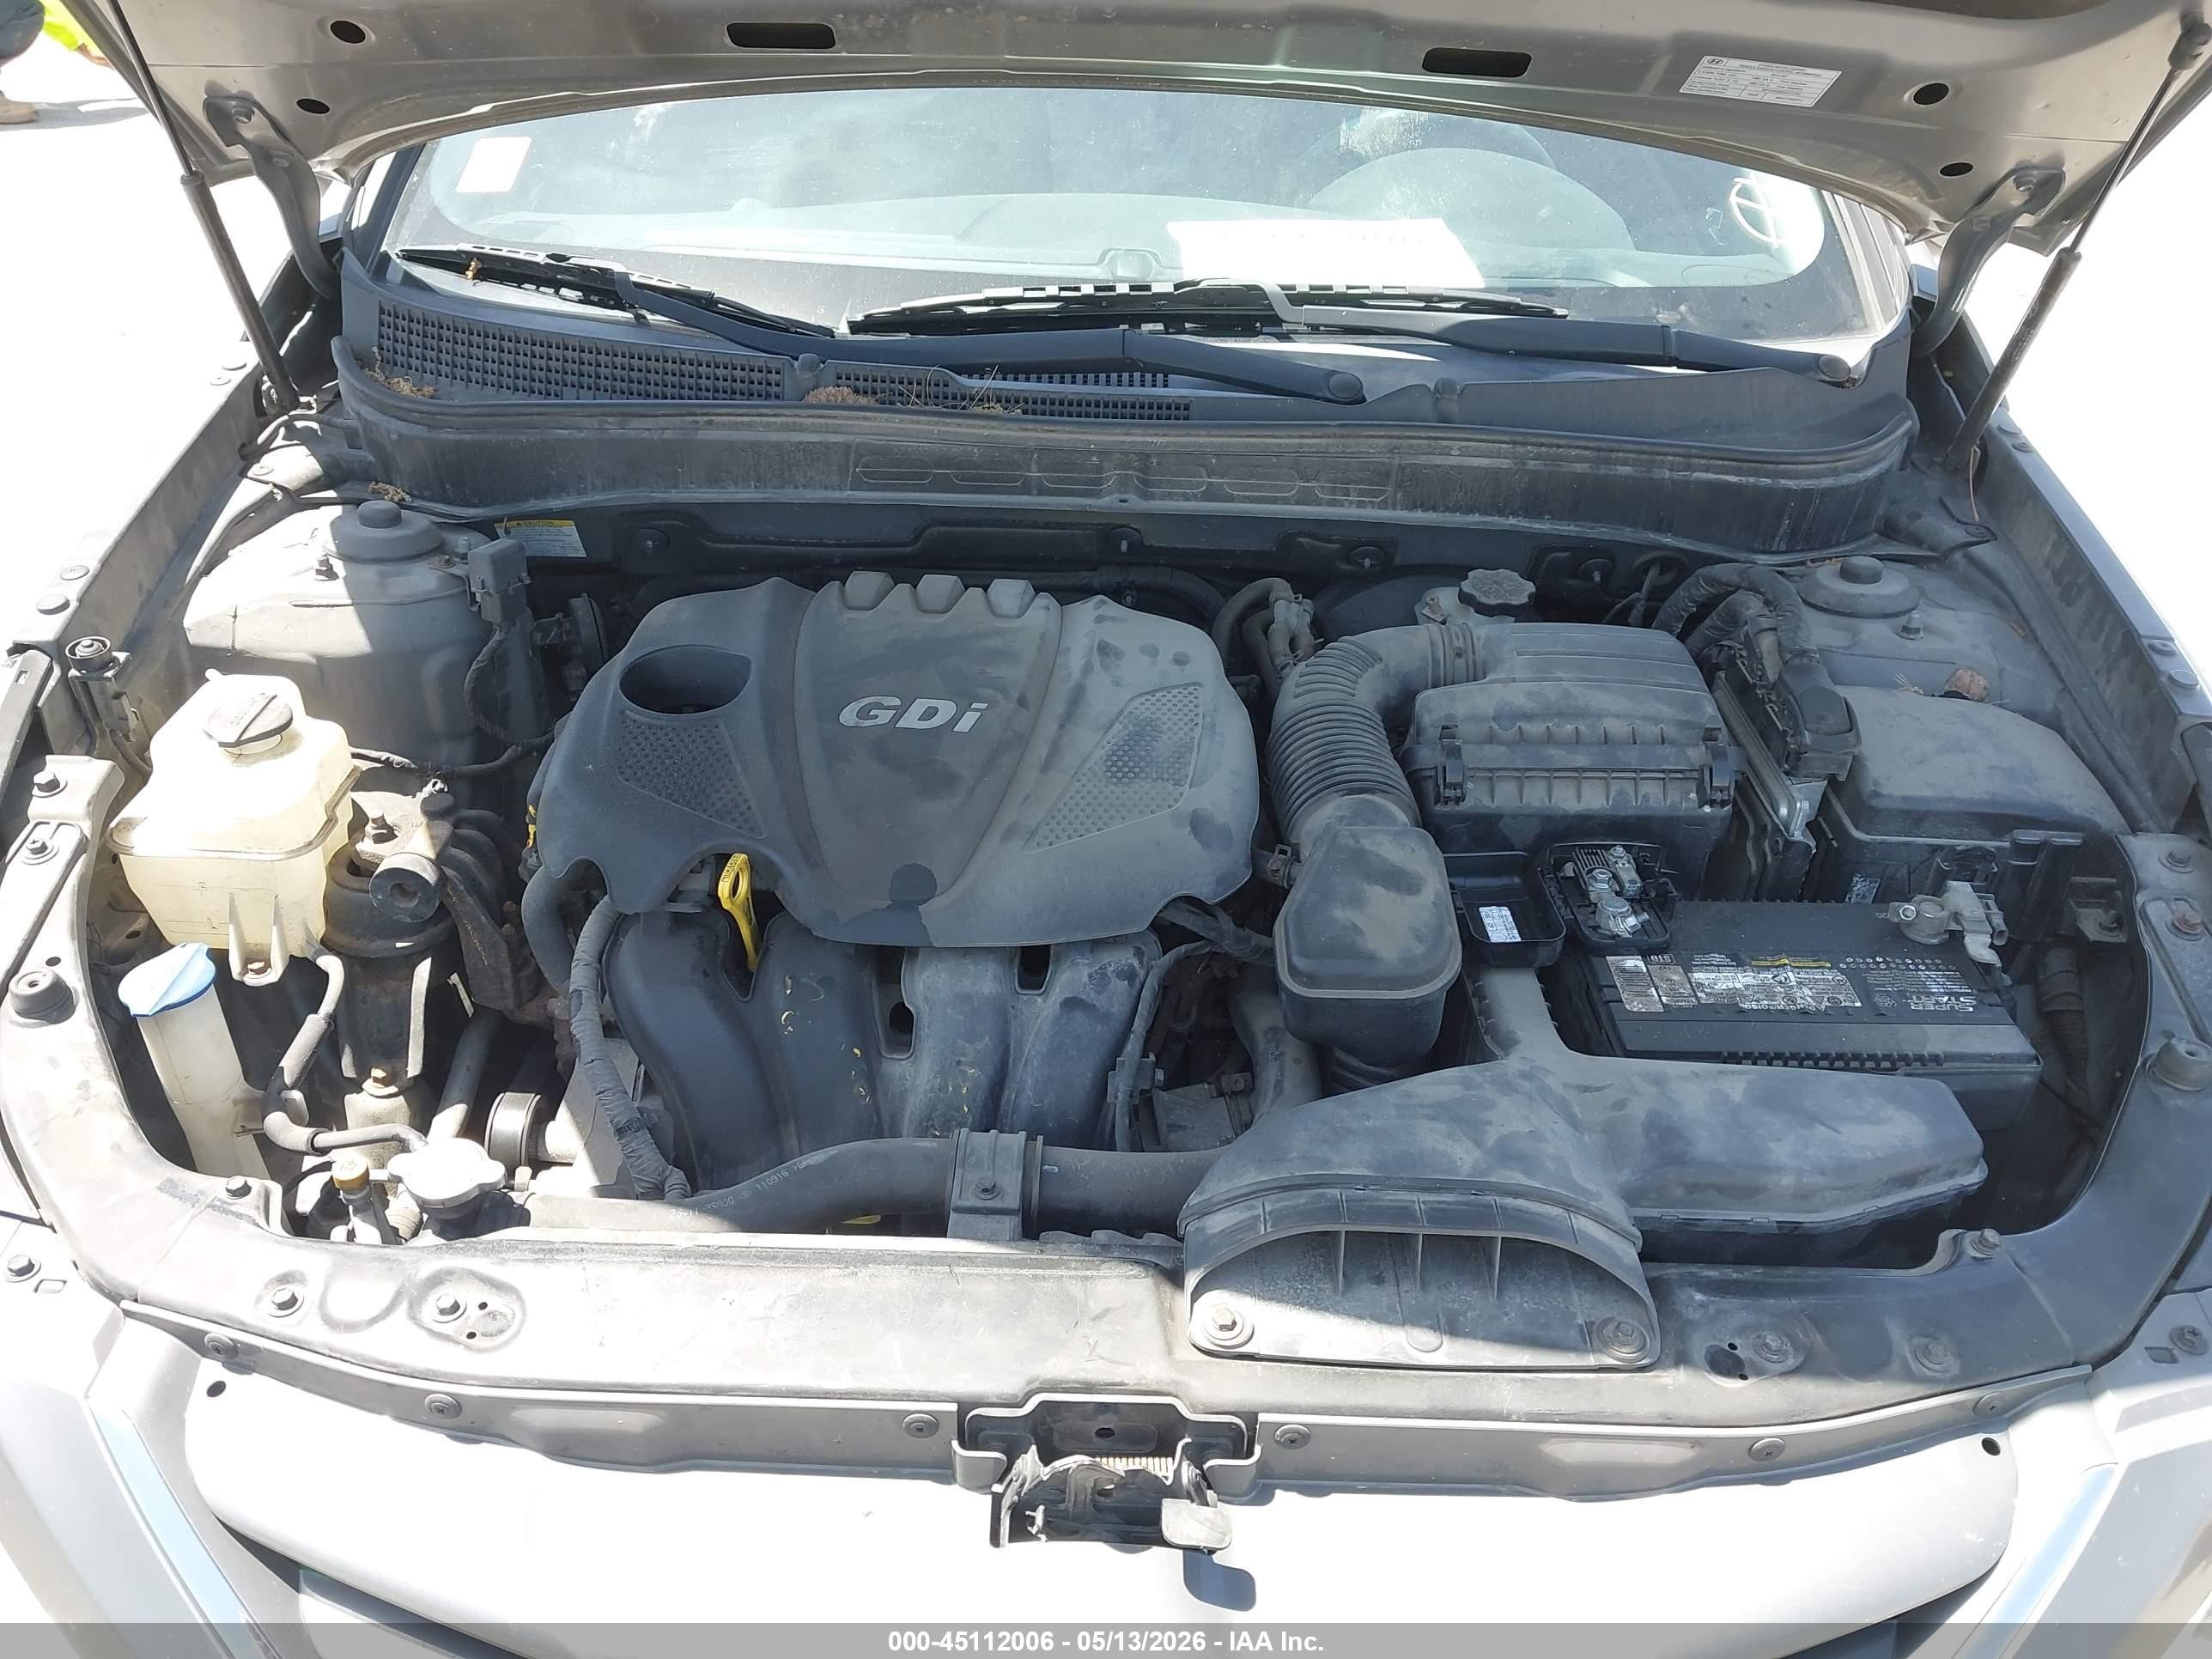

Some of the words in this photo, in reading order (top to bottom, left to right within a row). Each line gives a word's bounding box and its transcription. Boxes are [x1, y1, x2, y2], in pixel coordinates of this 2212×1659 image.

[838, 696, 988, 732] GDi
[1908, 995, 1977, 1005] START
[1910, 1003, 1974, 1012] SUPER
